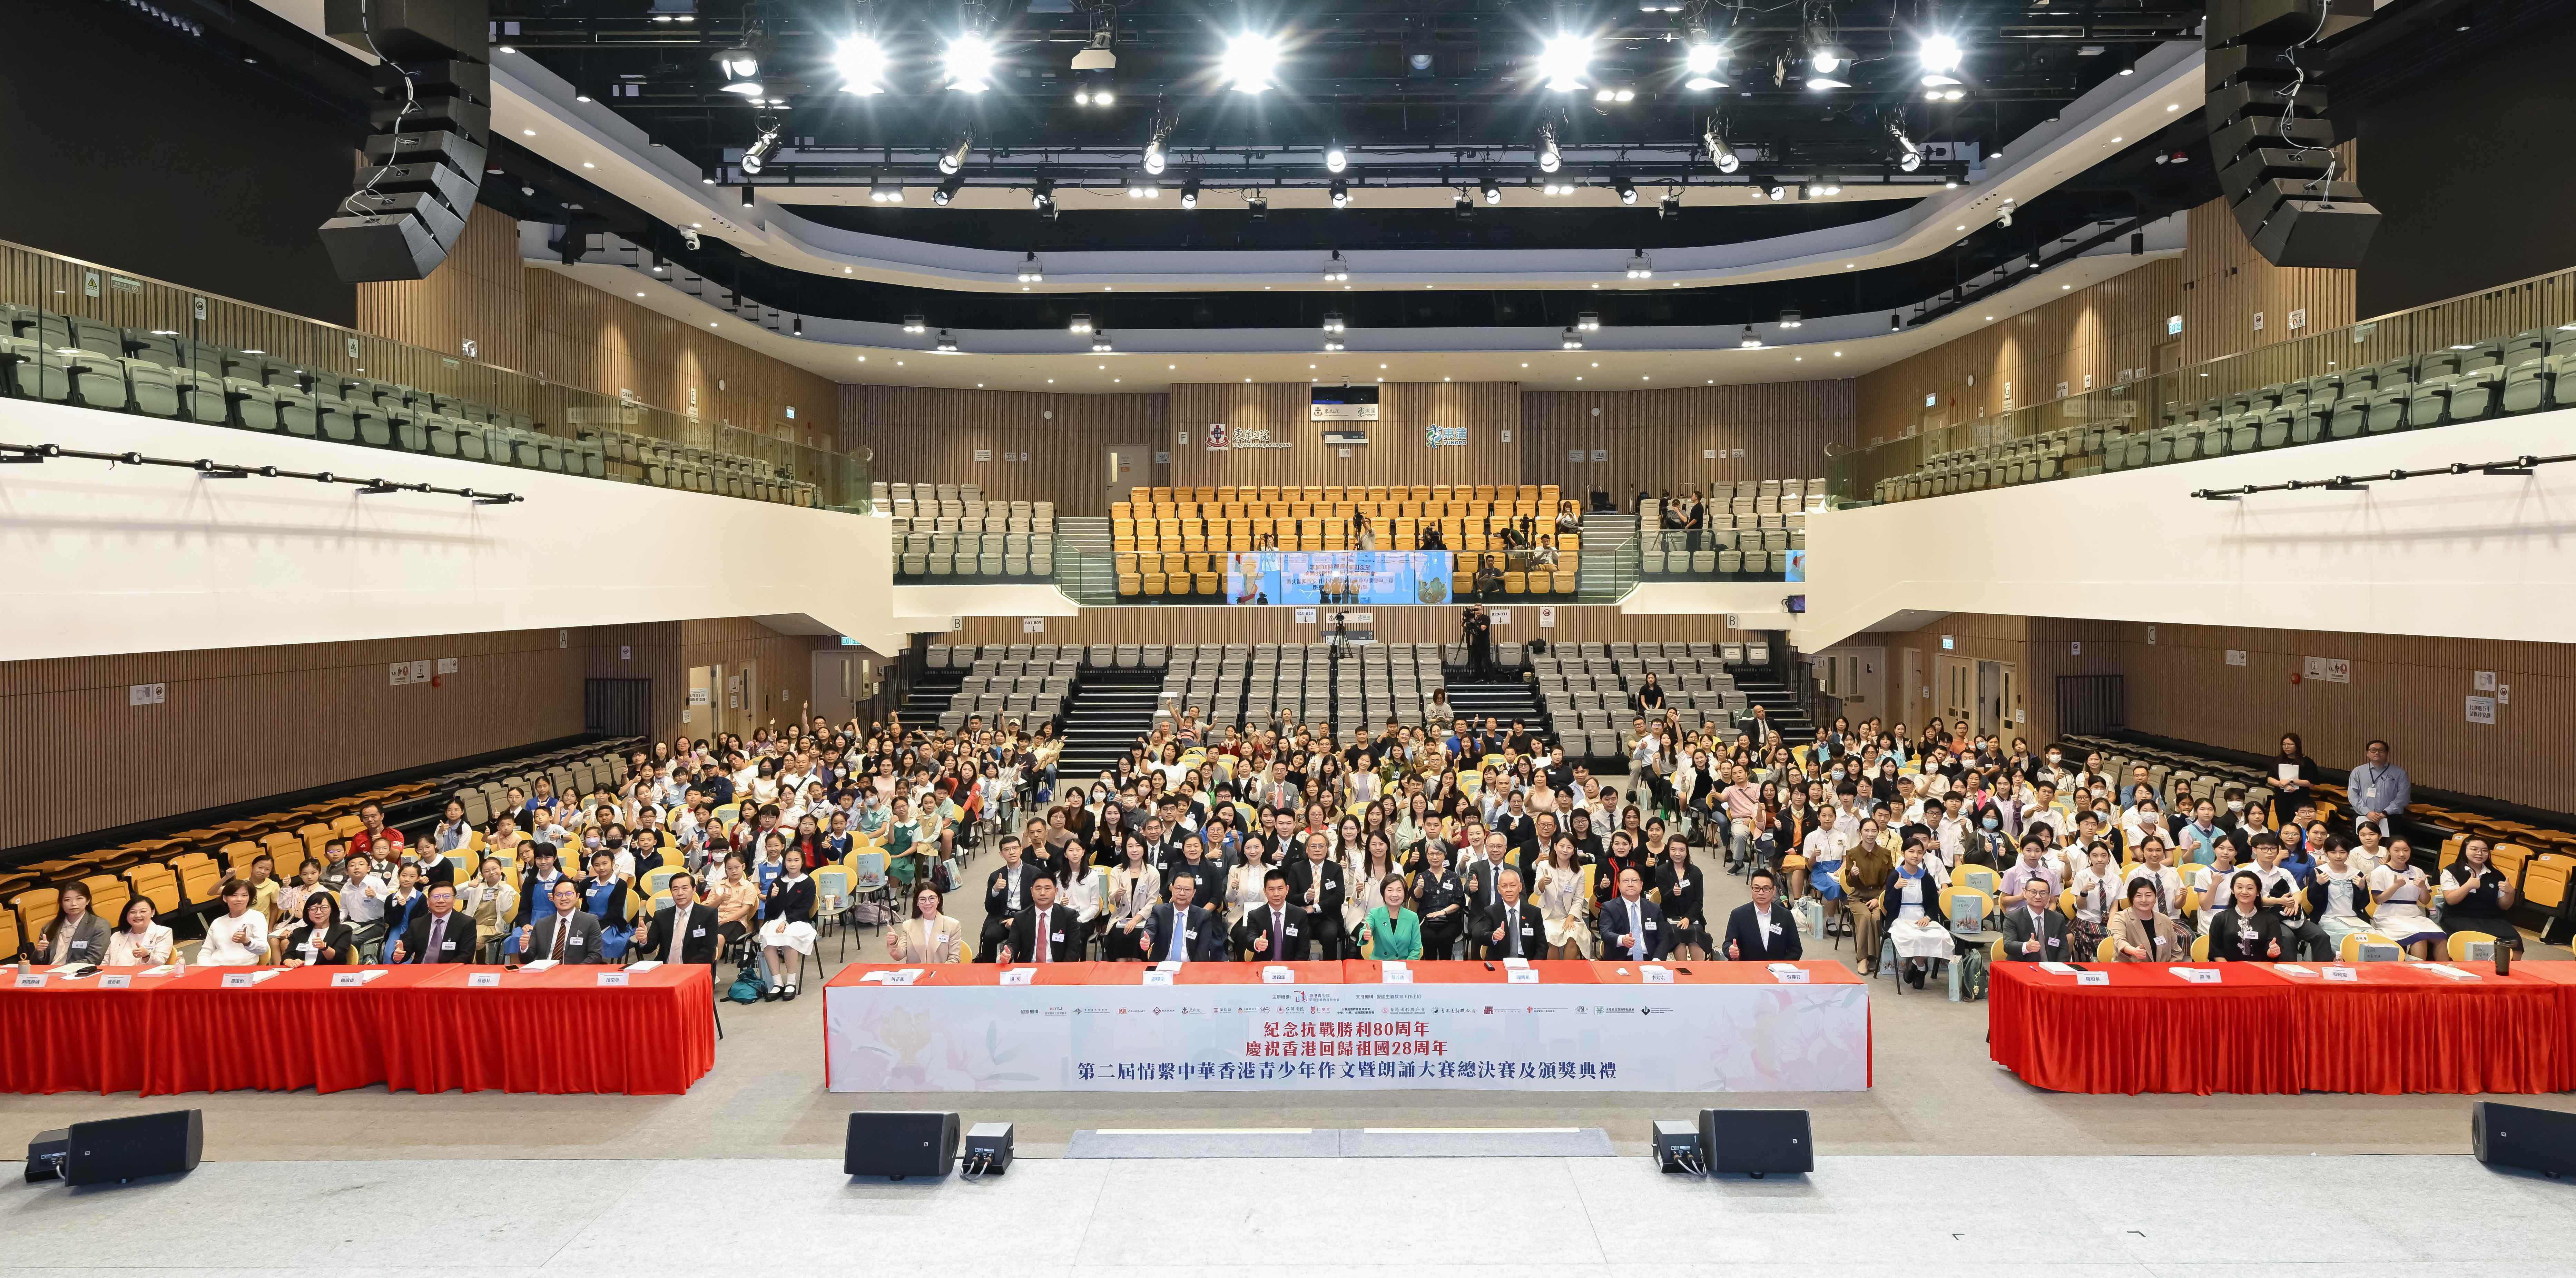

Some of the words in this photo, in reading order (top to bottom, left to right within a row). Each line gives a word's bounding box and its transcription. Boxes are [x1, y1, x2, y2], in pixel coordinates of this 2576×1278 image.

[692, 391, 695, 400] E
[2005, 385, 2009, 396] G
[1181, 434, 1186, 442] F
[1233, 428, 1269, 442] 東華三院
[1443, 428, 1467, 439] 東蒲
[954, 618, 961, 628] B
[1729, 616, 1736, 626] B
[2149, 629, 2155, 641] C
[1264, 1021, 1429, 1037] 紀念抗戰勝利80周年
[1245, 1040, 1448, 1057] 慶祝香港回歸祖國28周年
[1077, 1061, 1617, 1080] 第二屆情繫中華香港青少年作文暨朗誦大賽總決賽及頒獎典禮
